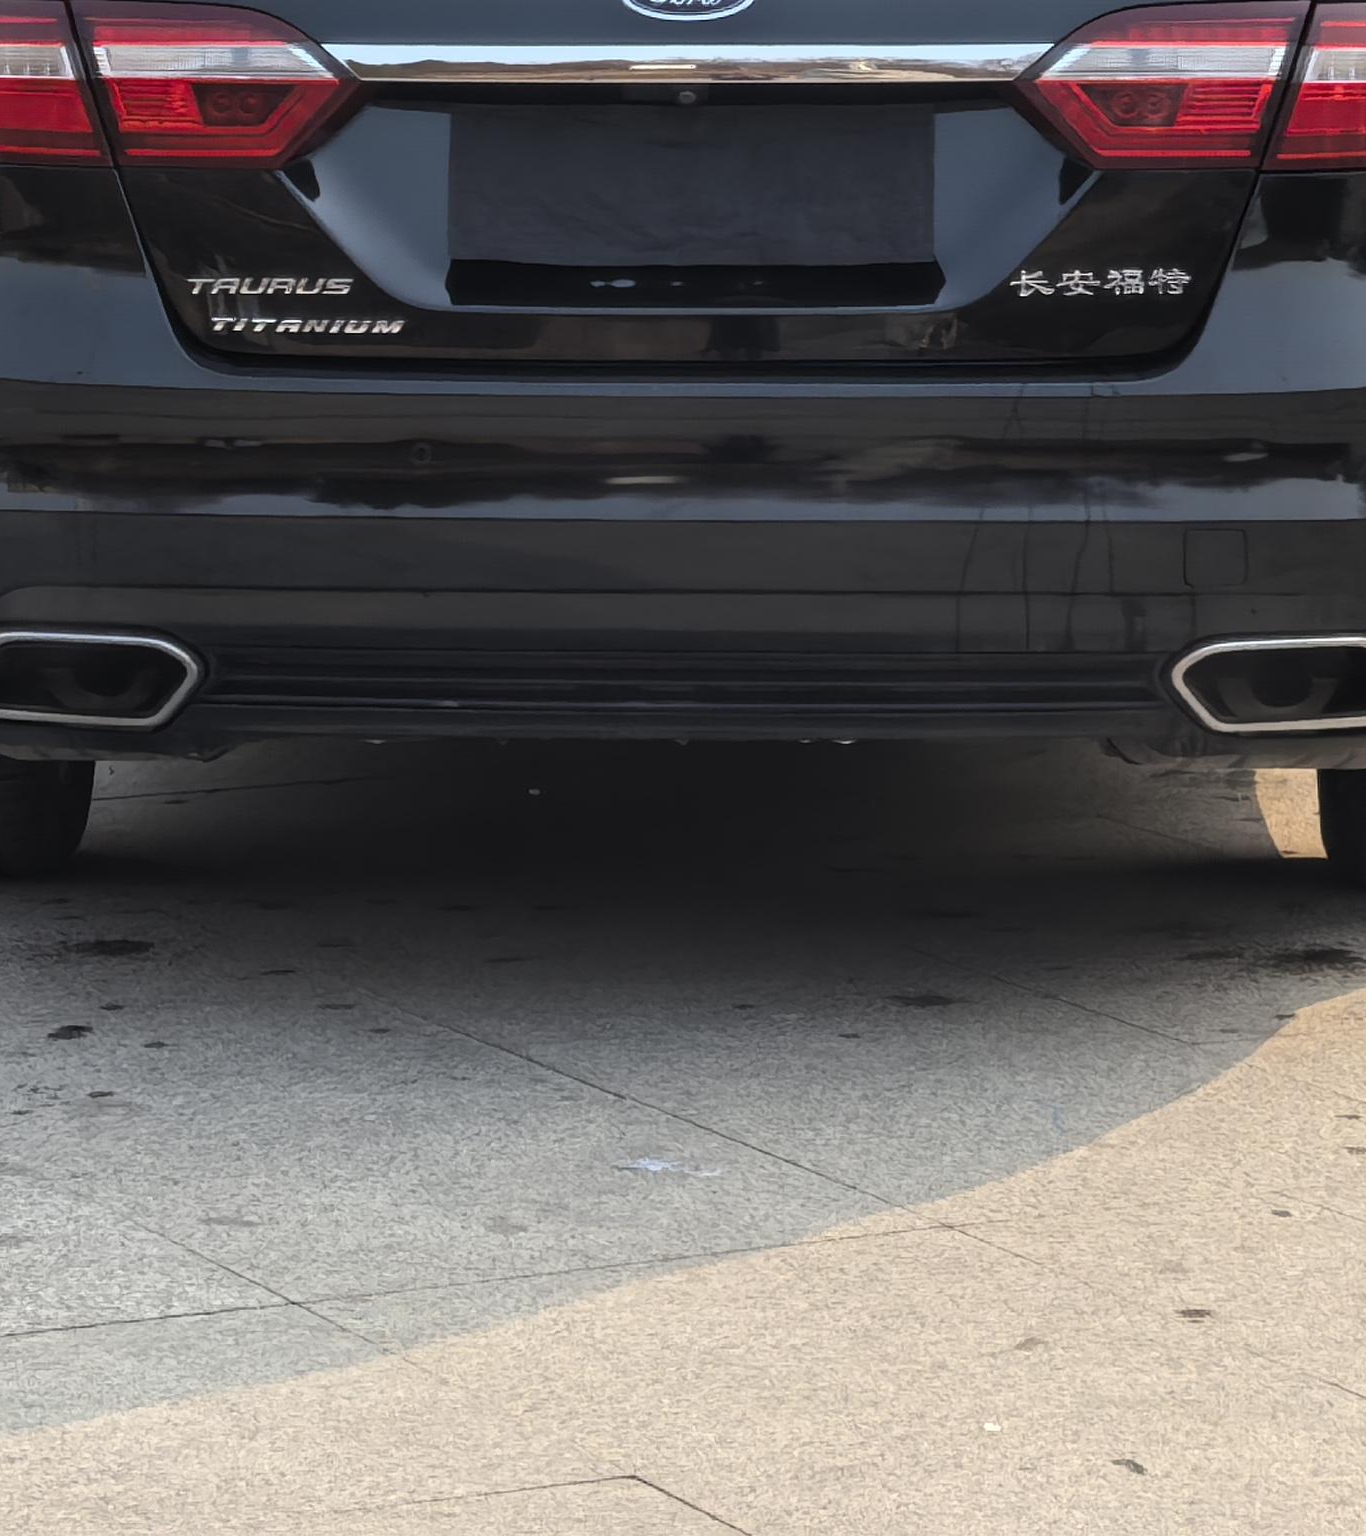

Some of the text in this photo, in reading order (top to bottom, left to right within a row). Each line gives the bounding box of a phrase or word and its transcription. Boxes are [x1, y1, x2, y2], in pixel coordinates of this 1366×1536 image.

[186, 277, 355, 296] TAURUS
[1009, 268, 1193, 298] 长安福特
[211, 317, 406, 335] TITANIUM
